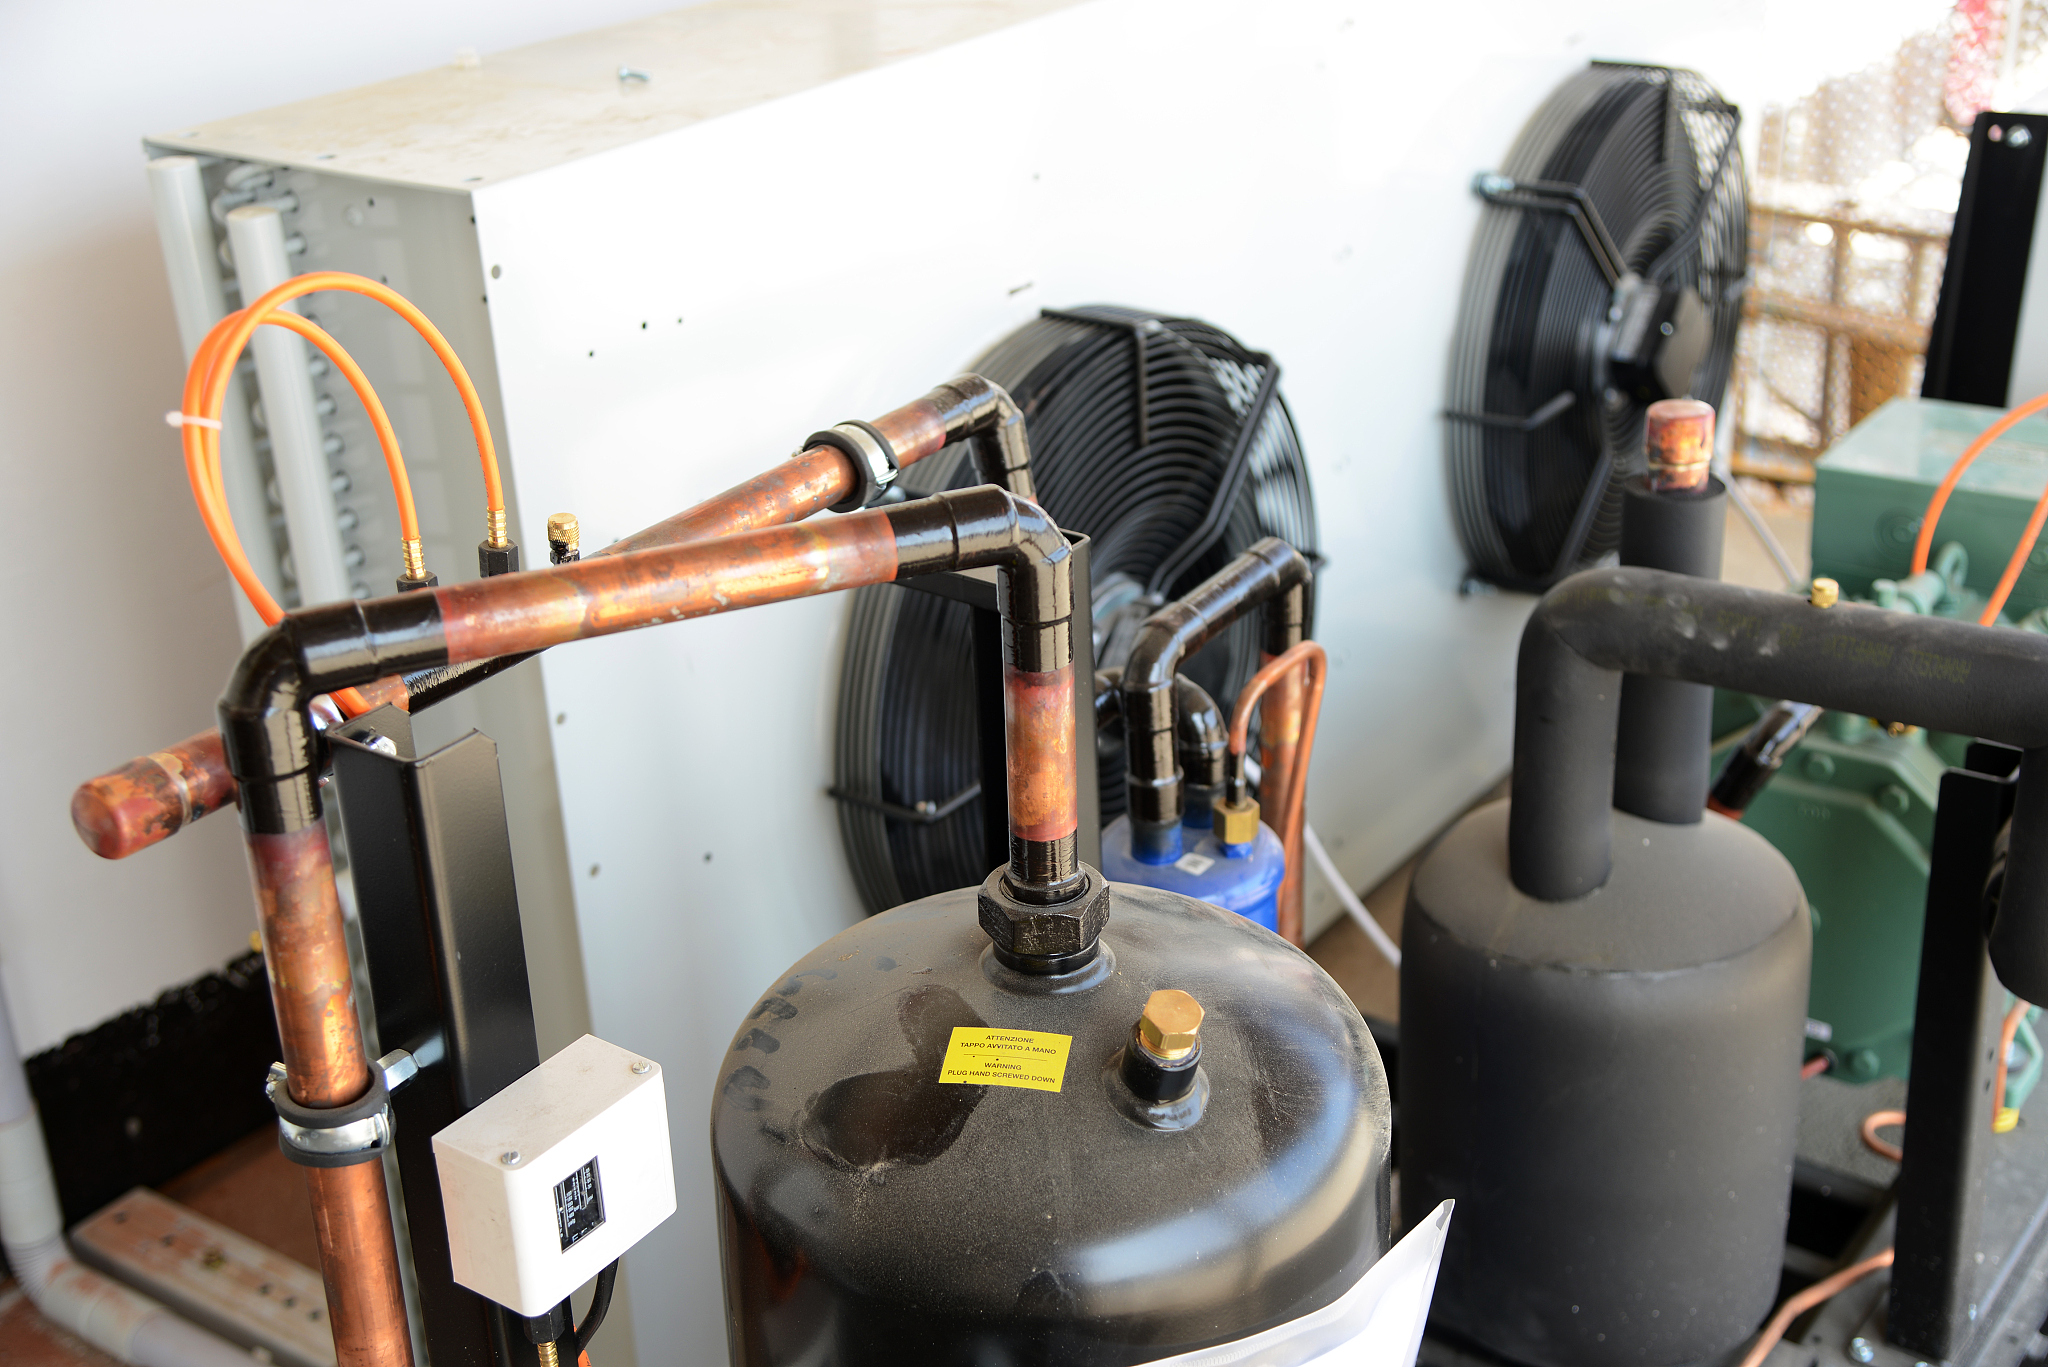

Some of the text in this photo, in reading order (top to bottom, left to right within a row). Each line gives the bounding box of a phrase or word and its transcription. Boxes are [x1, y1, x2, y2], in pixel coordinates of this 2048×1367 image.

[986, 1034, 1034, 1044] ATTENZIONE
[984, 1062, 1022, 1070] WARNING
[992, 1072, 1030, 1080] SCREWED
[1032, 1075, 1056, 1084] DOWN
